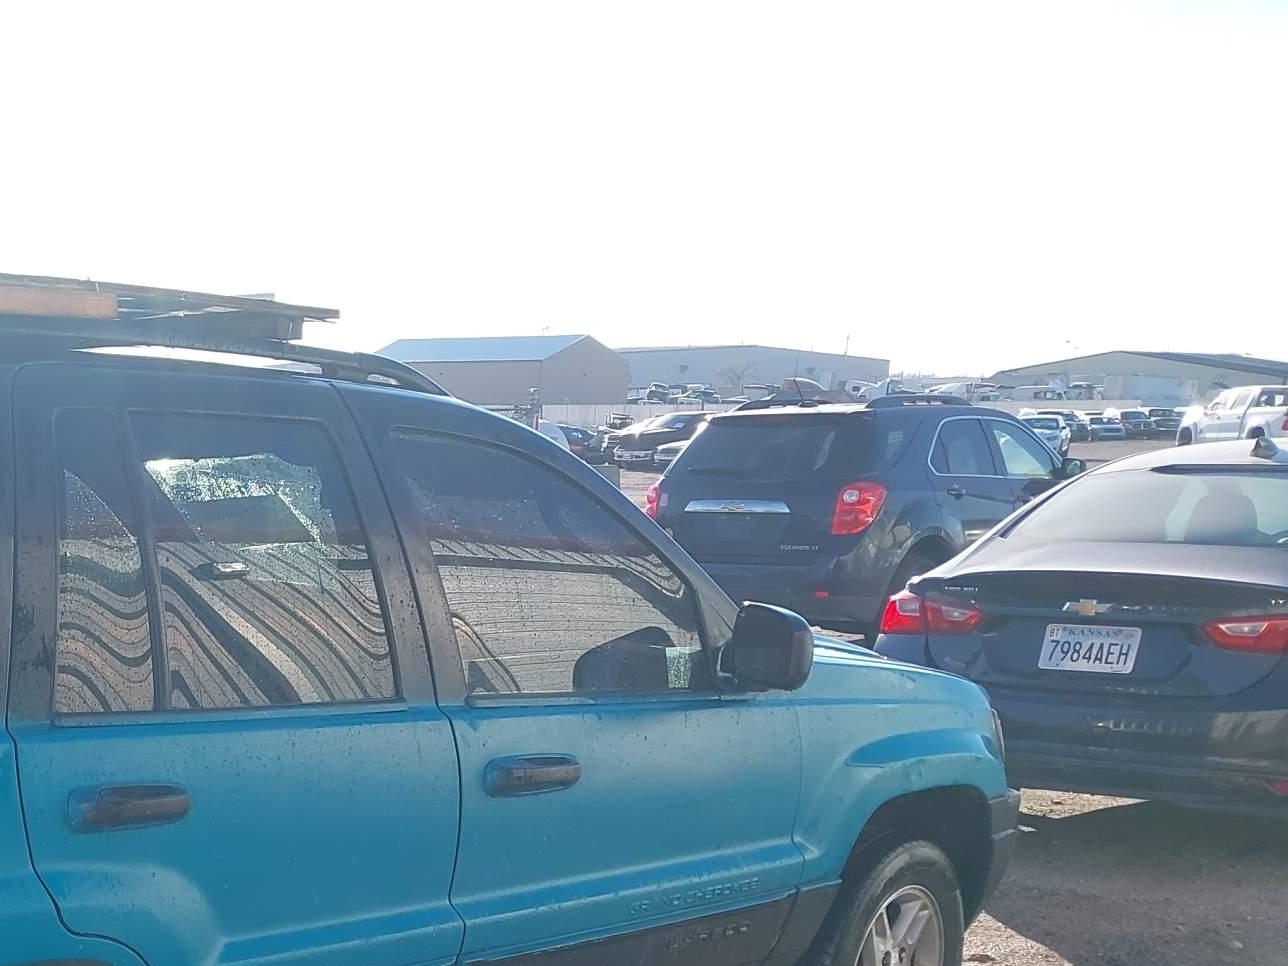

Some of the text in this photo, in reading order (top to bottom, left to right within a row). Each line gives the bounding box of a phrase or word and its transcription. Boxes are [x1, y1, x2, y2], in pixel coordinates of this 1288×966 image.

[1068, 628, 1119, 637] KANSAS
[1048, 640, 1131, 666] 7984AEH
[685, 877, 759, 904] CHEROKEE
